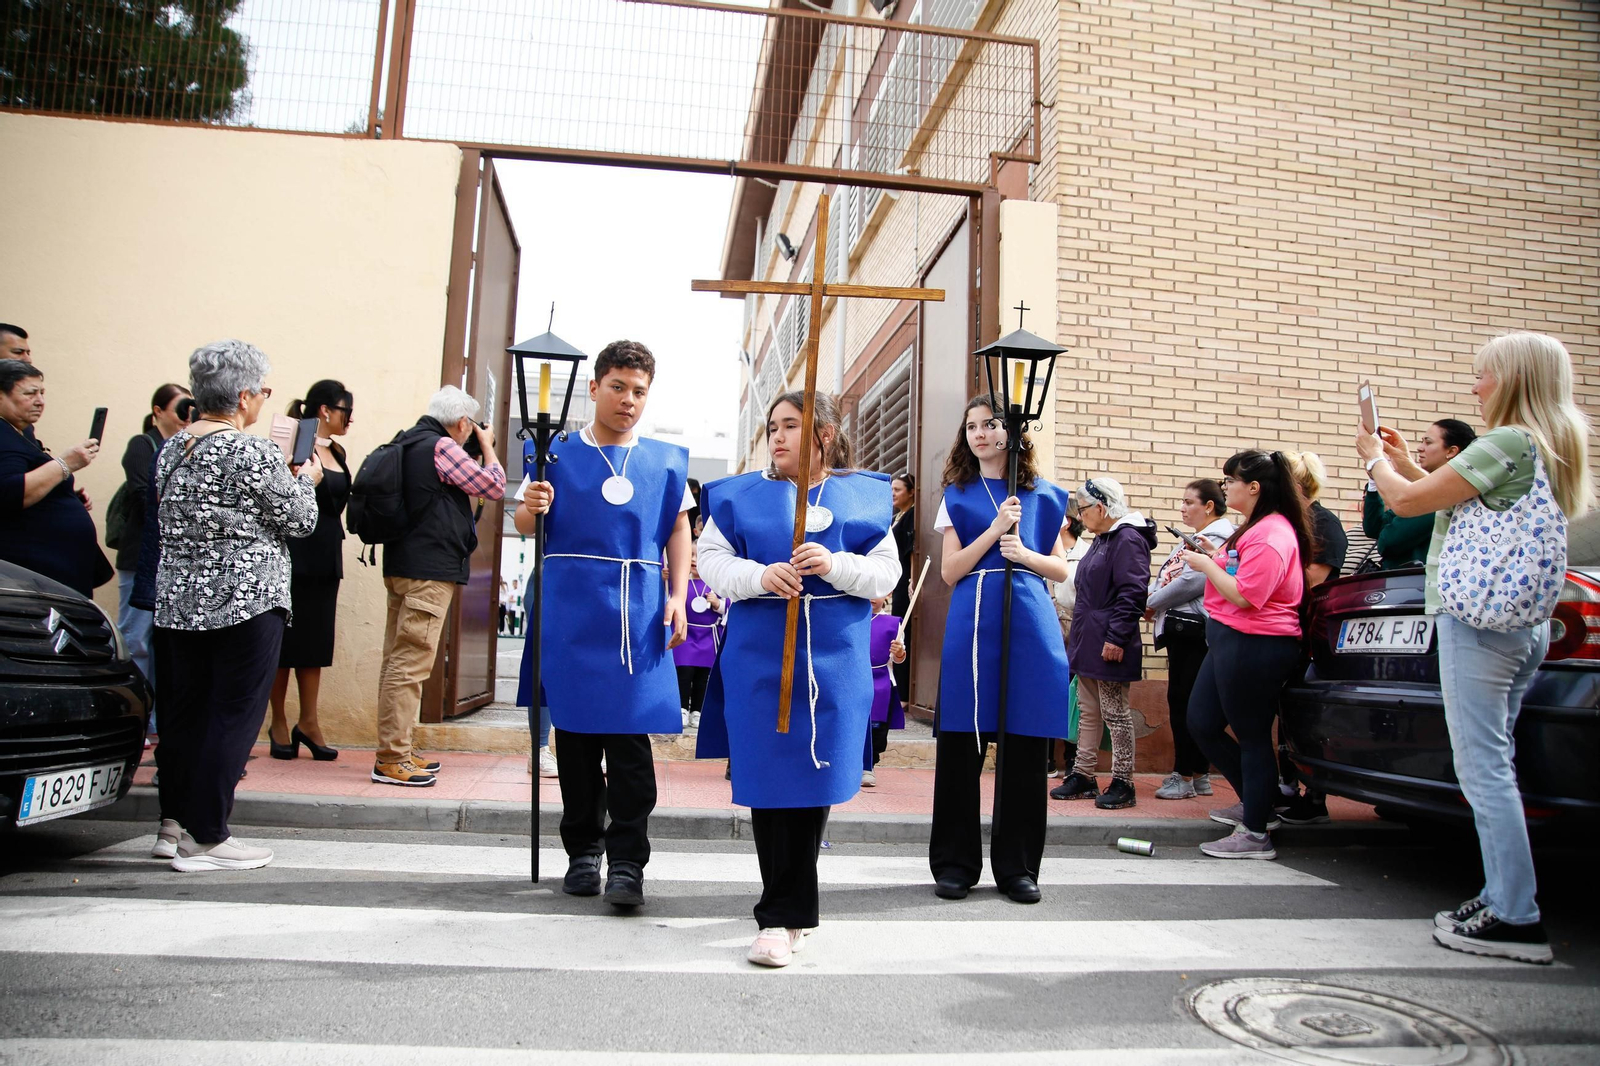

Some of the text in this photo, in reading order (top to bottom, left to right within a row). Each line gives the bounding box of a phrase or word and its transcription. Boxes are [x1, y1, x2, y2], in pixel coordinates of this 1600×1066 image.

[1347, 621, 1427, 644] 4784 FJR
[40, 767, 121, 810] 1829 FJZ
[23, 802, 29, 812] E
